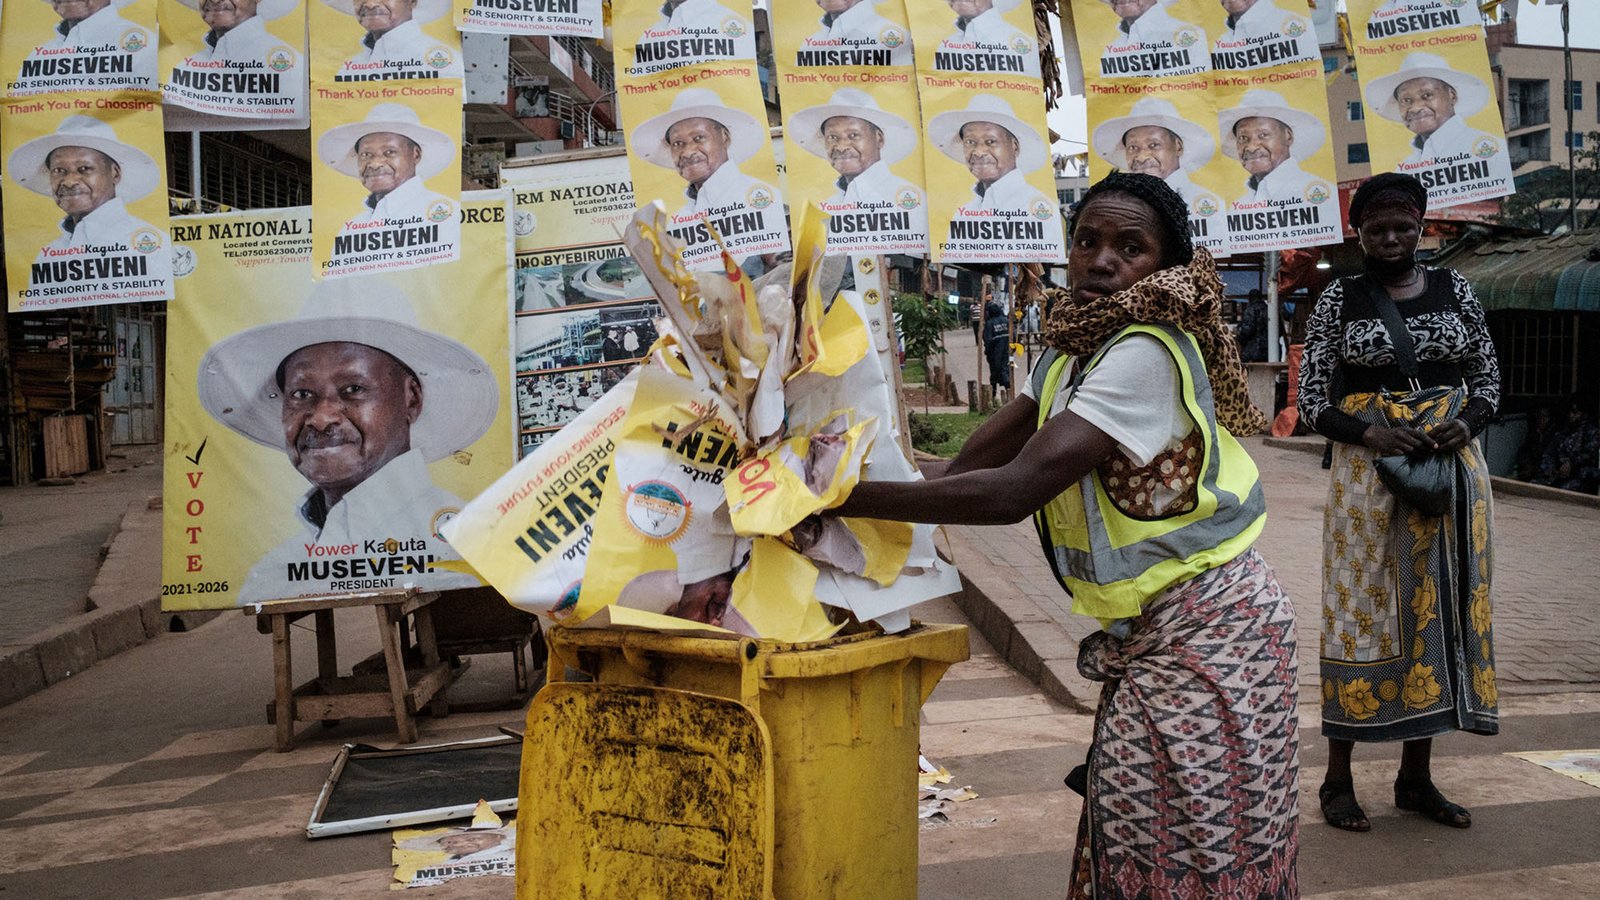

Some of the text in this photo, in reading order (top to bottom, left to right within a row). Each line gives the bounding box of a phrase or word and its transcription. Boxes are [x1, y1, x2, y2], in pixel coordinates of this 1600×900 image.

[463, 8, 482, 17] FOR
[485, 11, 534, 22] SENIORITY
[546, 16, 593, 26] STABILITY
[1367, 9, 1461, 39] MUSEVENI
[635, 39, 735, 63] MUSEVENI
[1358, 33, 1477, 55] Thank You for Choosing
[935, 52, 1025, 72] MUSEVENI
[1100, 49, 1191, 74] MUSEVENI
[1211, 39, 1299, 70] MUSEVENI
[22, 54, 133, 78] MUSEVENI
[624, 67, 643, 75] FOR
[7, 76, 150, 90] FOR SENIORITY & STABILITY
[172, 68, 280, 94] MUSEVENI
[624, 68, 751, 95] Thank You for Choosing
[784, 73, 908, 83] Thank You for Choosing
[924, 77, 1040, 94] Thank You for Choosing
[1232, 68, 1318, 86] You for Choosing
[158, 83, 178, 93] FOR
[180, 90, 234, 105] SENIORITY
[237, 96, 244, 105] &
[247, 98, 296, 106] STABILITY
[318, 86, 455, 99] Thank You for Choosing
[1091, 80, 1208, 94] Thank You for Choosing
[8, 96, 154, 115] Thank You for Choosing
[1460, 178, 1506, 192] STABILITY
[517, 192, 544, 205] RM
[572, 198, 607, 206] Located
[830, 212, 910, 233] USEVENI
[1227, 206, 1319, 233] MUSEVENI
[171, 225, 202, 242] RM
[209, 220, 302, 240] NATIONAL
[334, 224, 439, 255] MUSEVENI
[828, 235, 869, 244] ENIORITY
[881, 233, 925, 242] STABILITY
[950, 221, 1043, 239] MUSEVENI
[1235, 233, 1280, 242] SENIORITY
[1291, 225, 1335, 236] STABILITY
[224, 241, 258, 249] Located
[682, 242, 723, 258] ENIORITY
[735, 232, 781, 246] STABILITY
[322, 259, 341, 268] FOR
[343, 253, 394, 265] SENIORITY
[406, 243, 453, 257] STABILITY
[31, 255, 147, 284] MUSEVENI
[19, 288, 40, 298] FOR
[43, 284, 98, 296] SENIORITY
[112, 279, 165, 289] STABILITY
[536, 439, 616, 511] PRESIDENT
[186, 472, 205, 573] VOTE
[304, 543, 358, 557] Yower
[288, 554, 434, 581] MUSEVENI
[161, 581, 229, 596] 2021-2026
[330, 578, 395, 590] PRESIDENT
